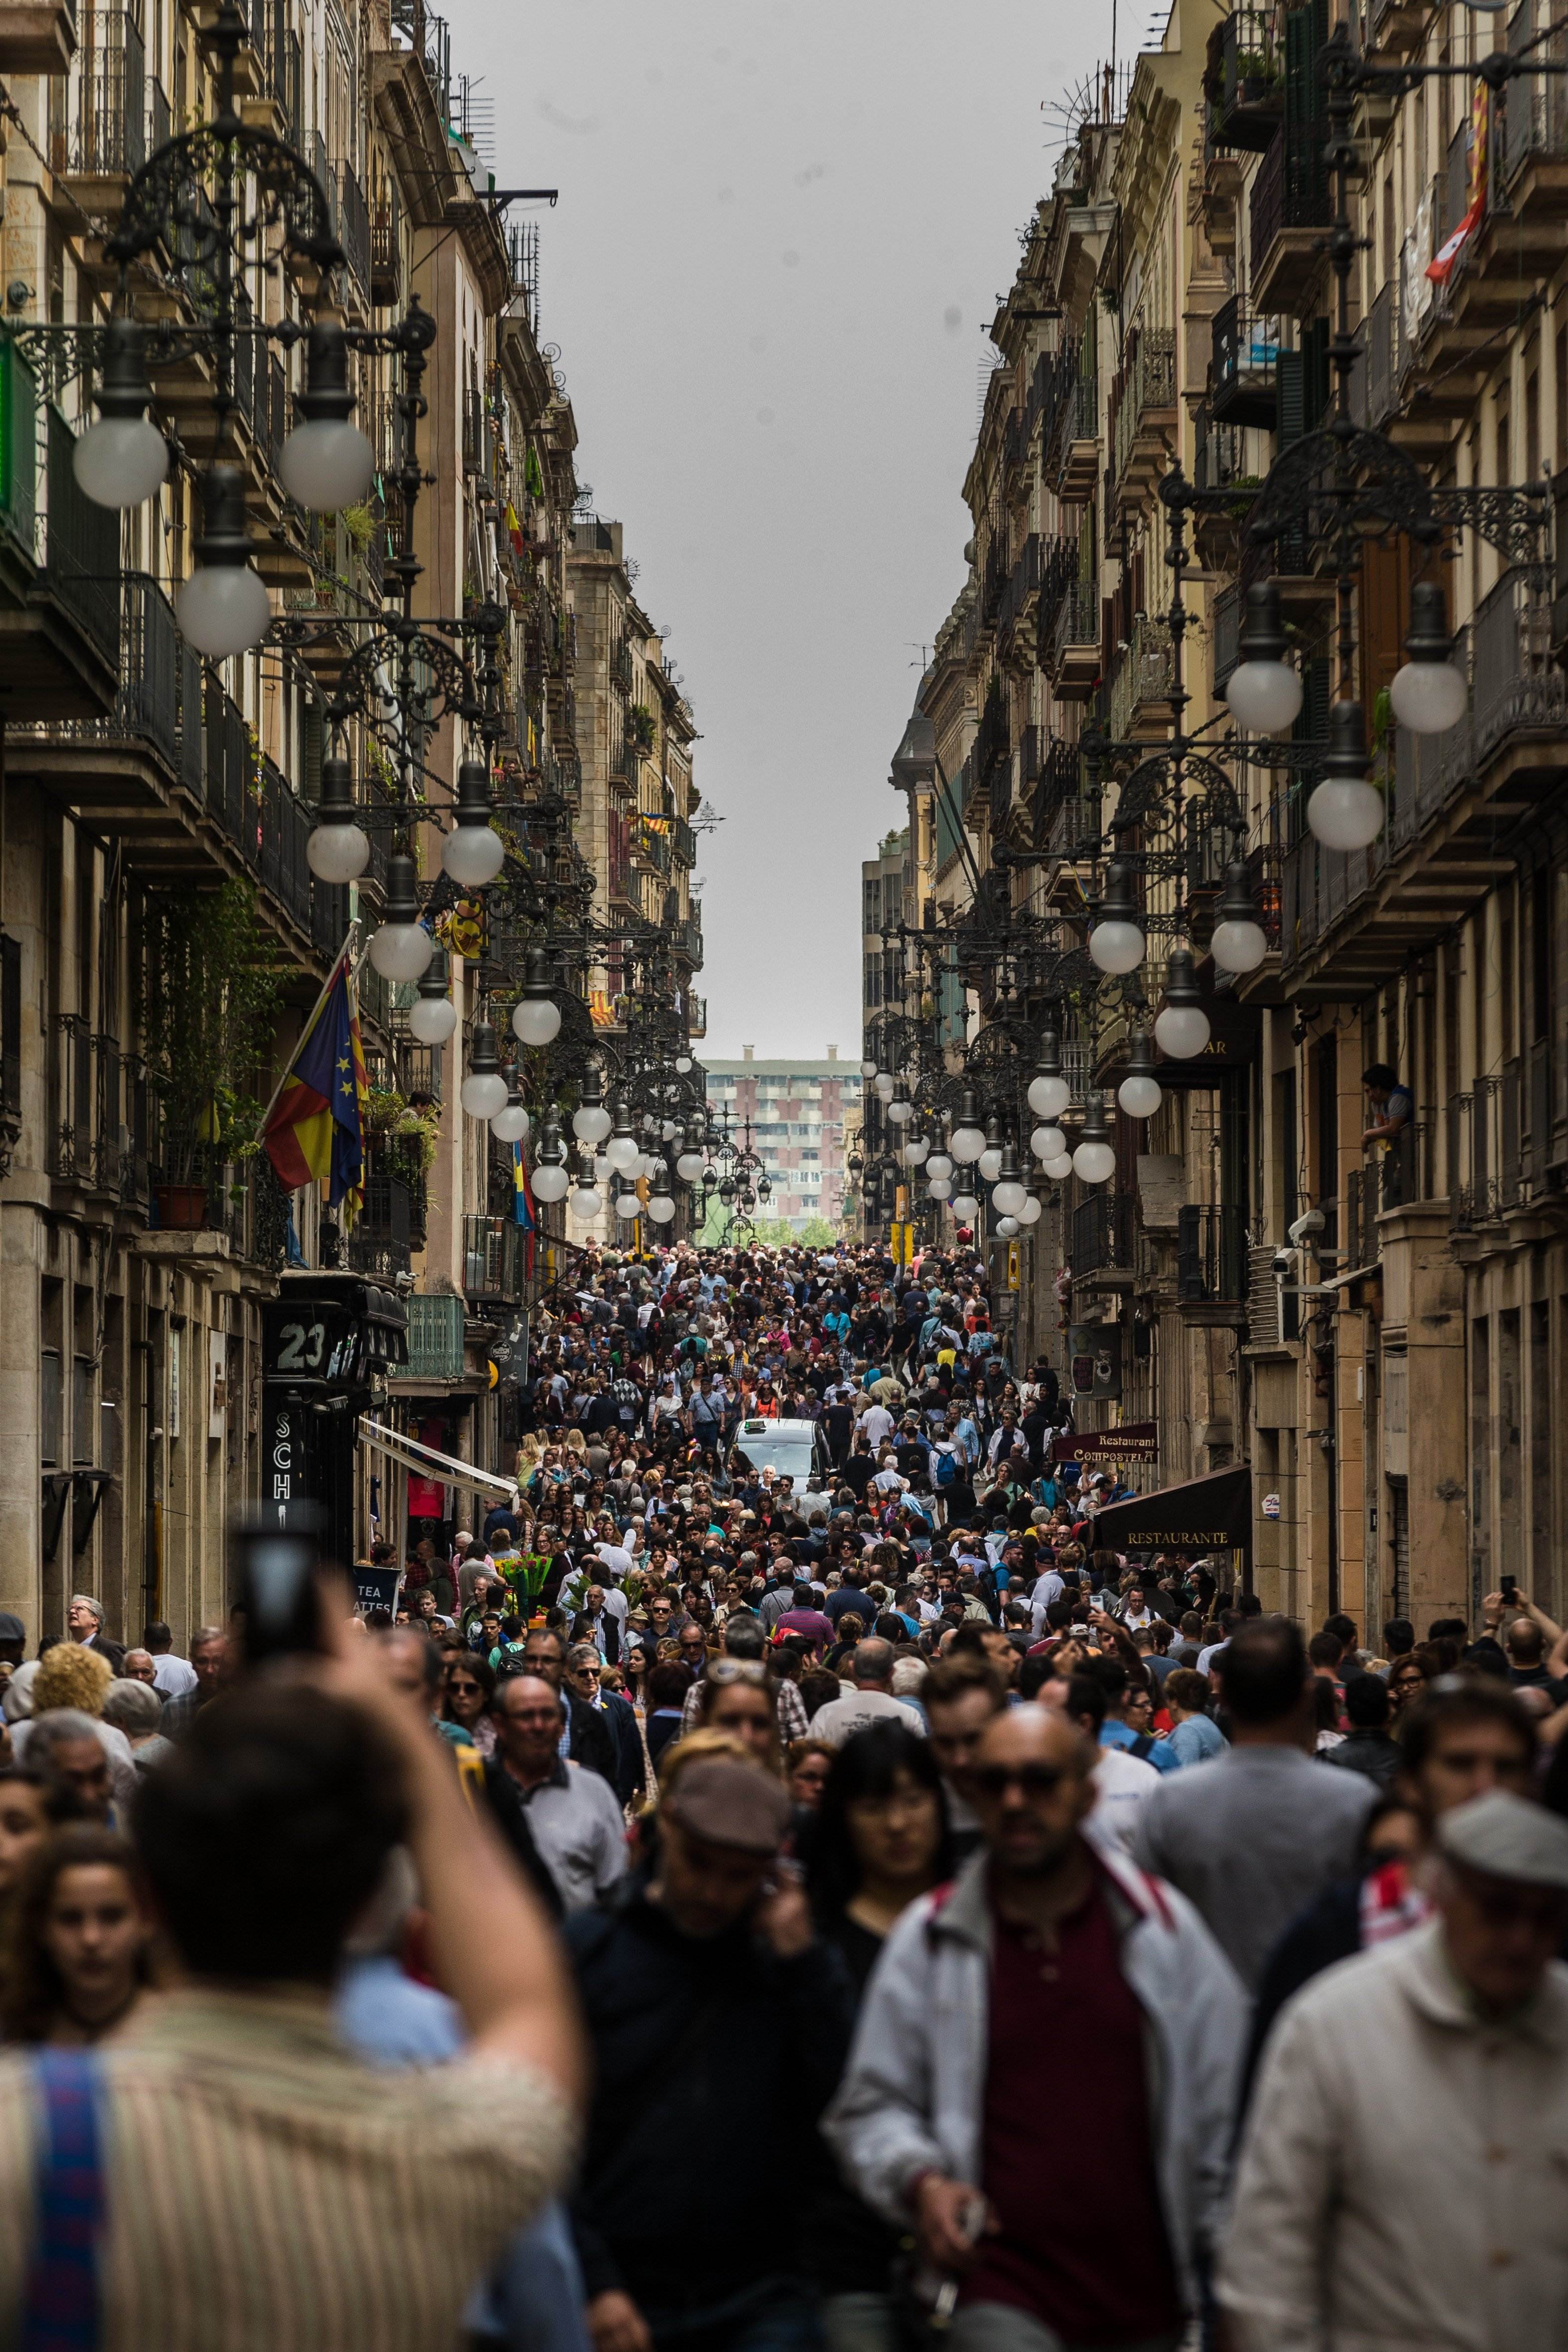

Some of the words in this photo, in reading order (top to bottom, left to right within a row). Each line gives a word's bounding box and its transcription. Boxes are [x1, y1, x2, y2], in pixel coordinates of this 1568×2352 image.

[1202, 1041, 1228, 1054] AR
[278, 1323, 325, 1369] 23
[1099, 1435, 1155, 1447] Restaurant
[1073, 1449, 1154, 1463] COMPOSTELA
[273, 1412, 291, 1529] SCHI
[1128, 1532, 1228, 1544] RESTAURANTE
[358, 1586, 381, 1597] TEA
[353, 1601, 390, 1613] ATTES
